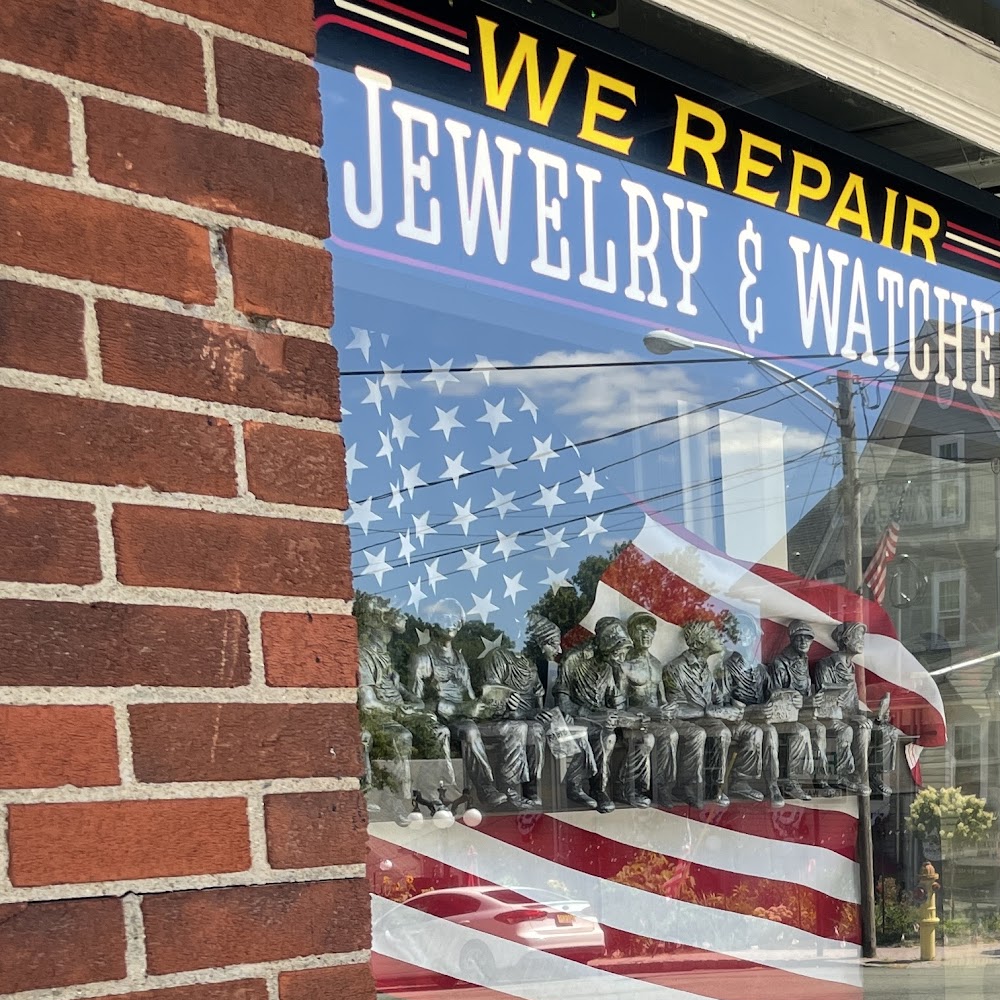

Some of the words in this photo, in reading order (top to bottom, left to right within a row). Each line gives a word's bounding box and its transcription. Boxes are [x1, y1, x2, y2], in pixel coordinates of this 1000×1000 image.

[342, 65, 709, 316] JEWELRY
[736, 218, 764, 344] &
[475, 15, 638, 156] WE
[667, 94, 943, 266] REPAIR
